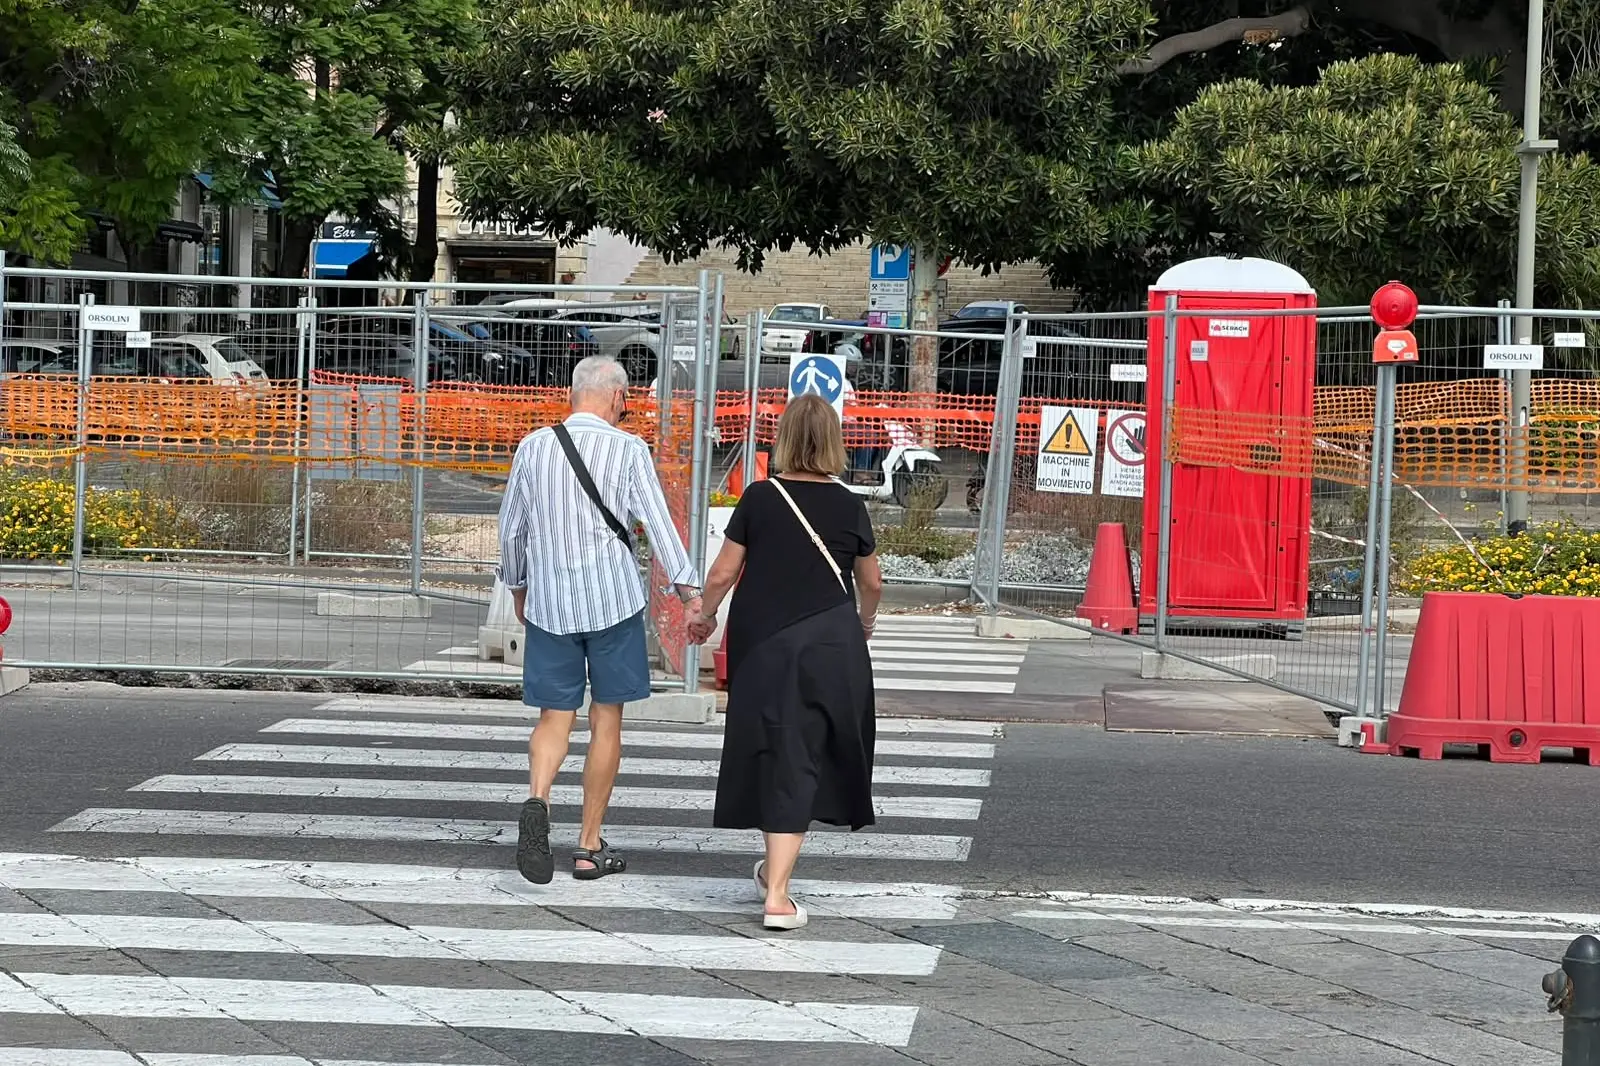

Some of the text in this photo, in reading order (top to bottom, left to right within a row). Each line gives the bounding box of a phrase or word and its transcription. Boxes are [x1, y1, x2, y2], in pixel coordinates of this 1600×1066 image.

[333, 225, 356, 238] Bar
[877, 241, 902, 274] P
[88, 314, 130, 323] ORSOLINI
[1489, 352, 1532, 360] ORSOLINI
[1043, 456, 1090, 467] MACCHINE
[1061, 468, 1070, 477] IN
[1037, 478, 1092, 490] MOVIMENTO
